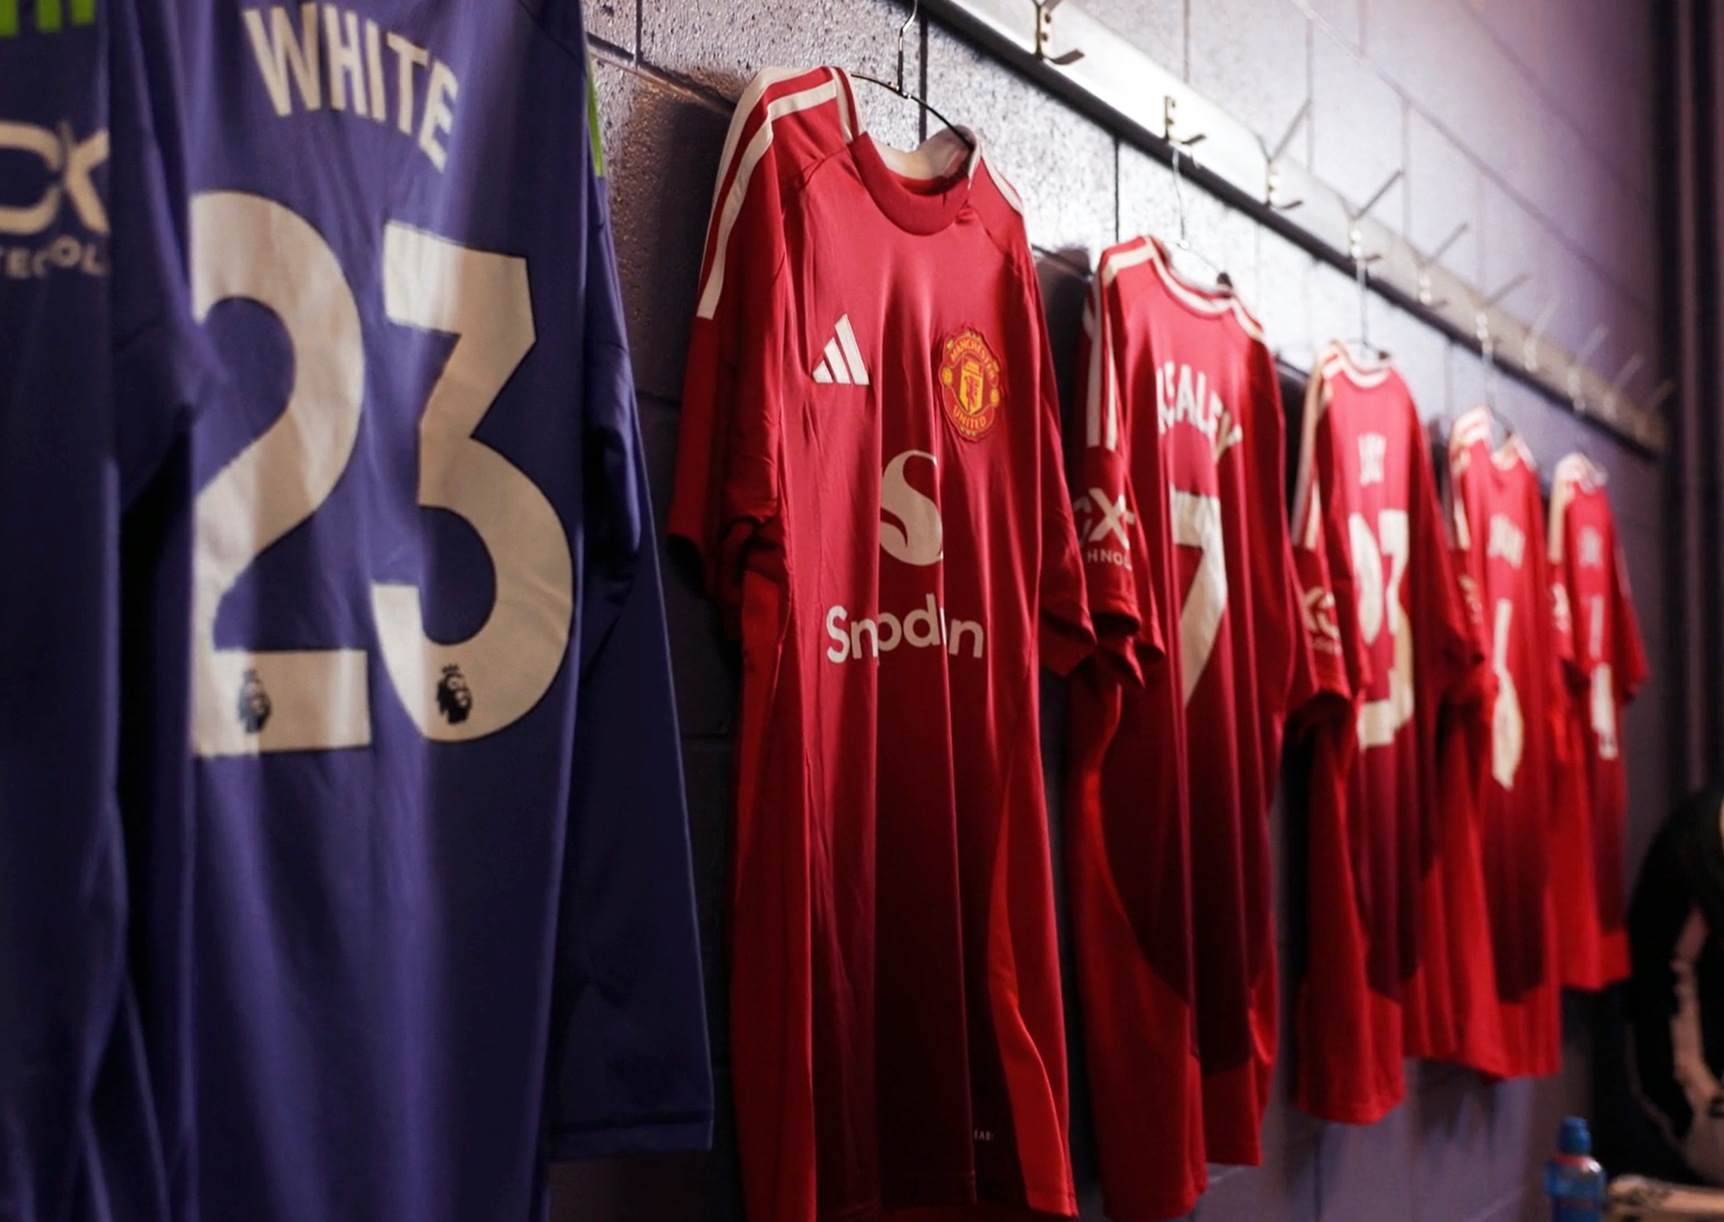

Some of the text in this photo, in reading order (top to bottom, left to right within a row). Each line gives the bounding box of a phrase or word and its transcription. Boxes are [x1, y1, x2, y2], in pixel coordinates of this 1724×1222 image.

[243, 3, 459, 173] WHITE
[190, 190, 574, 758] 23
[952, 405, 987, 430] UNITED
[1168, 481, 1229, 710] 7
